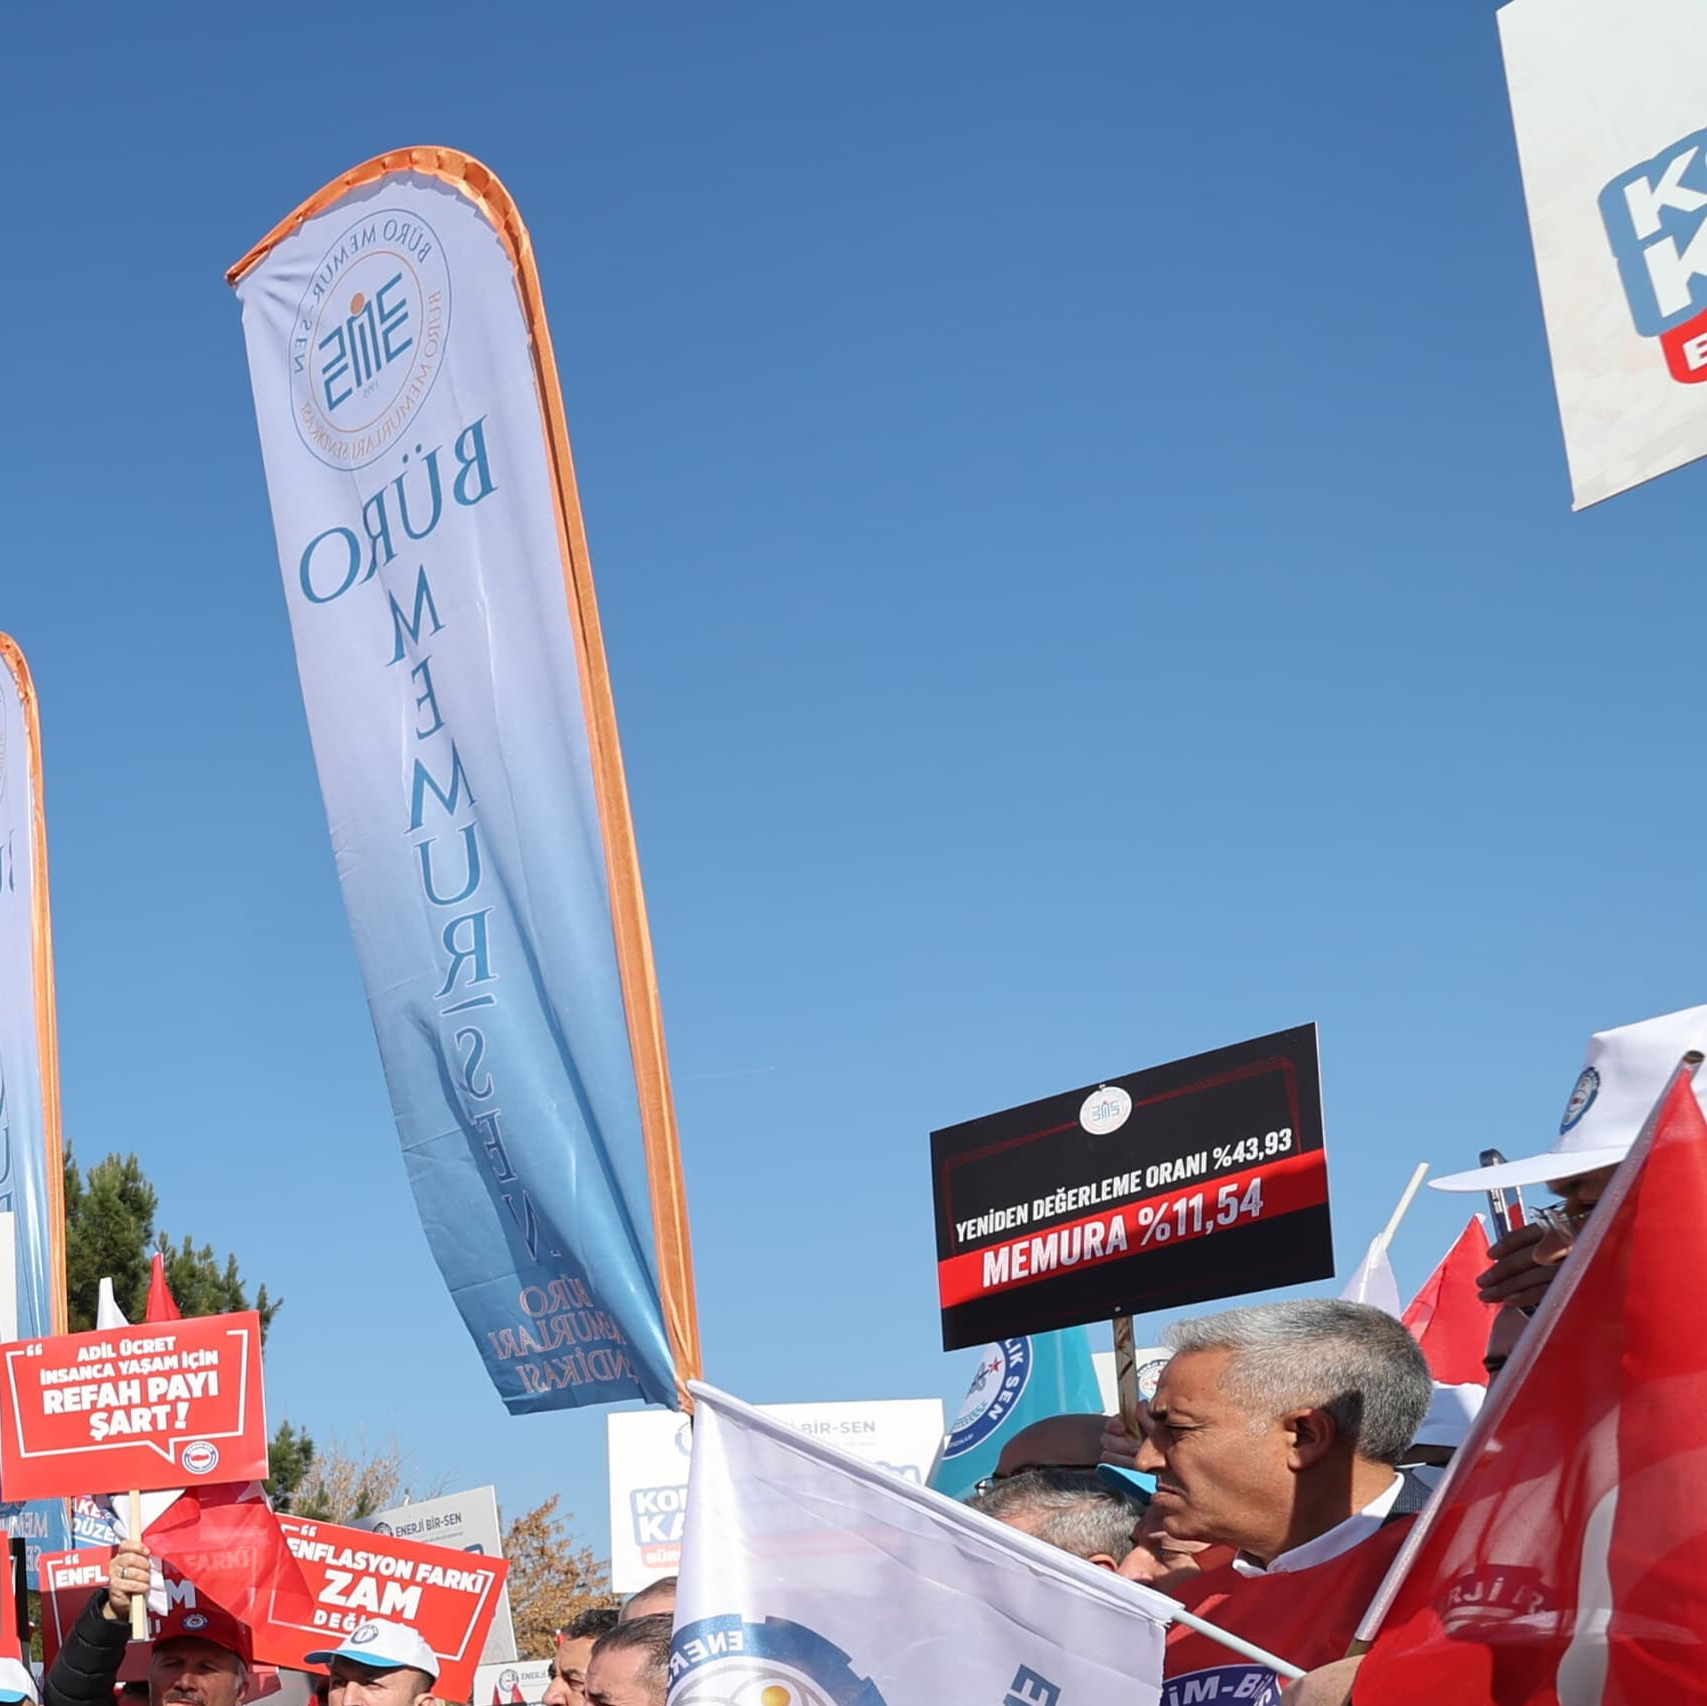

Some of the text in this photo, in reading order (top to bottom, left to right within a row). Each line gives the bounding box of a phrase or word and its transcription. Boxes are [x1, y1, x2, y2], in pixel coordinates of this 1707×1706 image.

[956, 1128, 1292, 1242] YENİDEN DEĞERLEME ORANI %43,93
[982, 1177, 1263, 1287] MEMURA %11,54
[40, 1348, 219, 1385] İNSANCA YAŞAM İÇİN
[77, 1336, 176, 1362] ADİL ÜCRET
[43, 1370, 219, 1415] REFAH PAYI
[318, 1569, 423, 1620] ZAM
